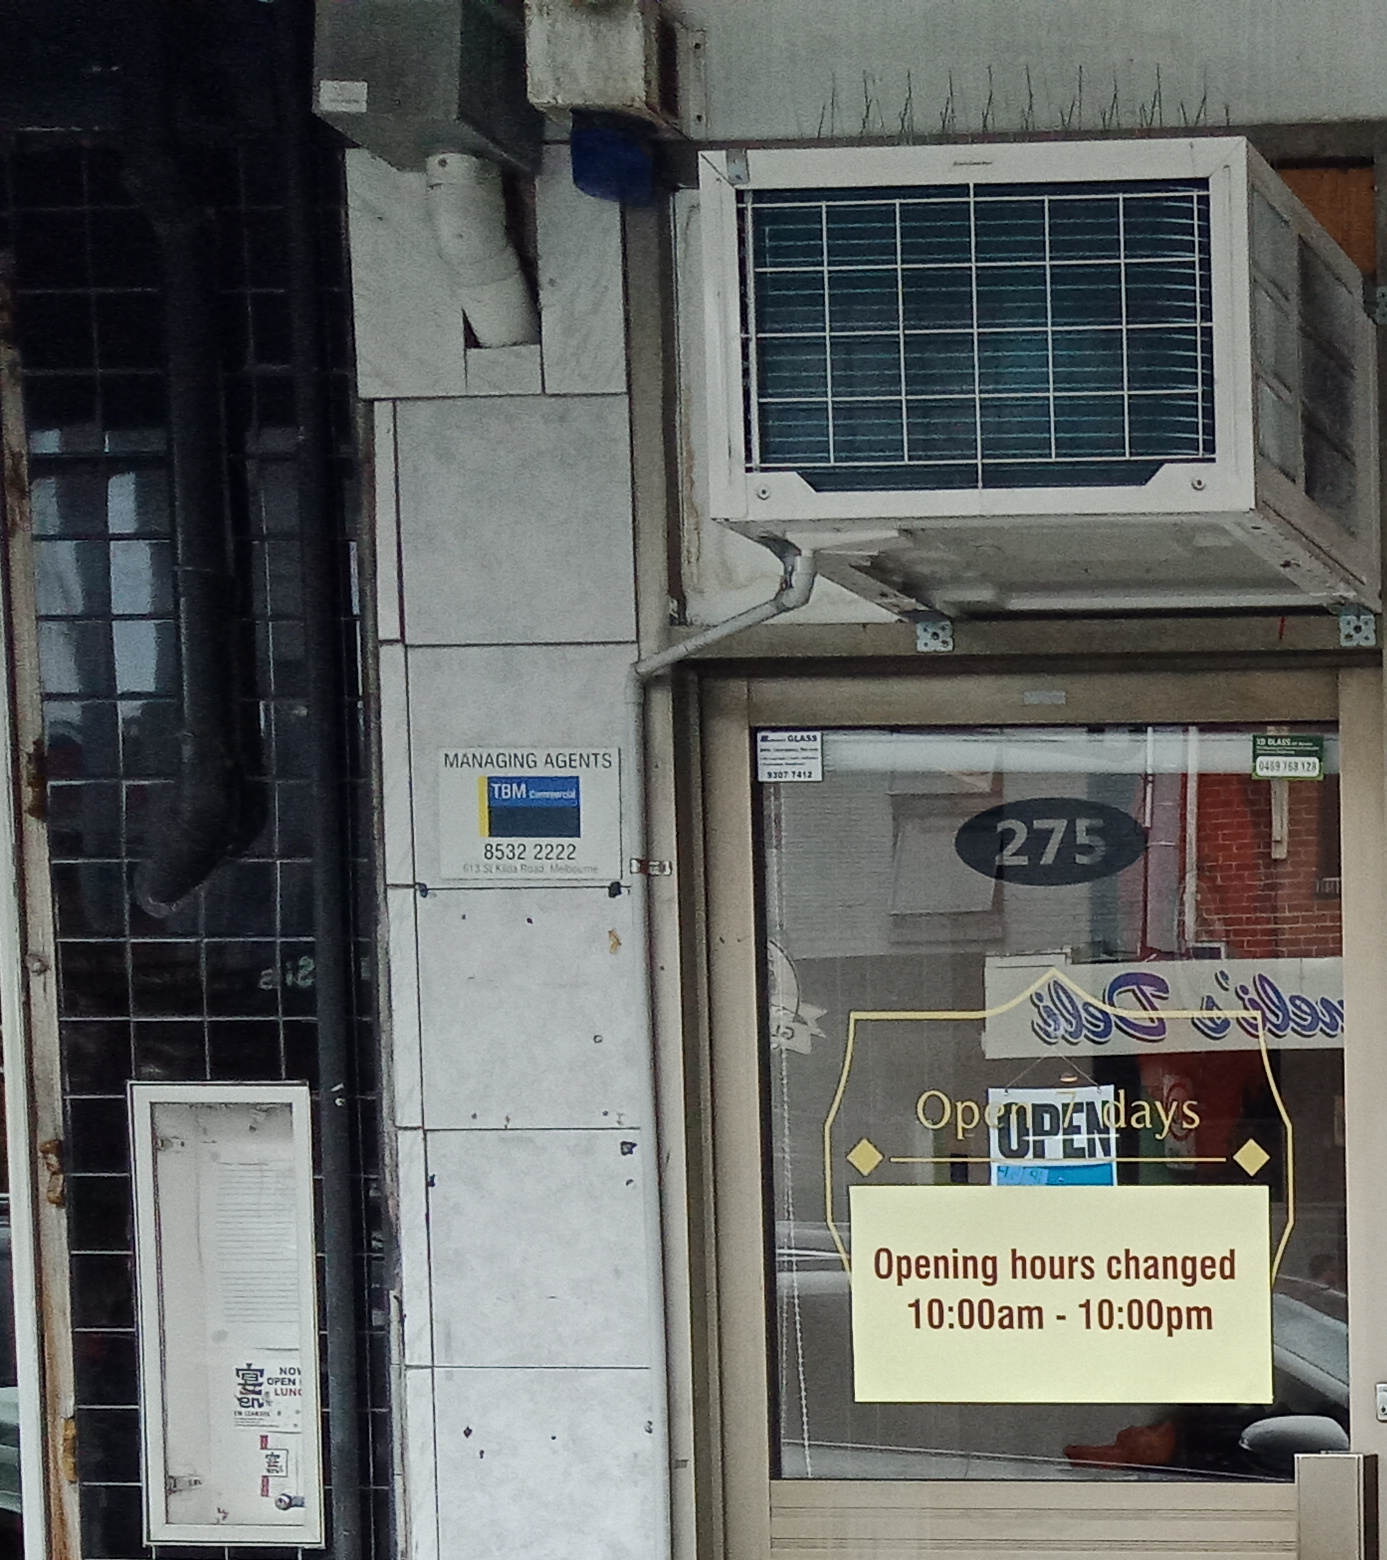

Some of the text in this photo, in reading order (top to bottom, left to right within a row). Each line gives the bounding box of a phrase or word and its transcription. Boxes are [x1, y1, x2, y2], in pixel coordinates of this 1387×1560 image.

[787, 734, 817, 743] GLASS
[1268, 738, 1291, 746] GLASS
[444, 752, 612, 769] MANAGING AGENTS
[491, 783, 527, 799] TBM
[994, 818, 1107, 866] 275
[484, 843, 577, 861] 8532 2222
[916, 1088, 1201, 1142] Open 7 days
[998, 1101, 1114, 1161] OPEN
[874, 1247, 1237, 1287] Opening hours changed
[907, 1298, 1045, 1331] 10:00am
[1078, 1298, 1213, 1337] 10:00pm
[278, 1366, 302, 1376] NO
[266, 1377, 297, 1386] OPEN
